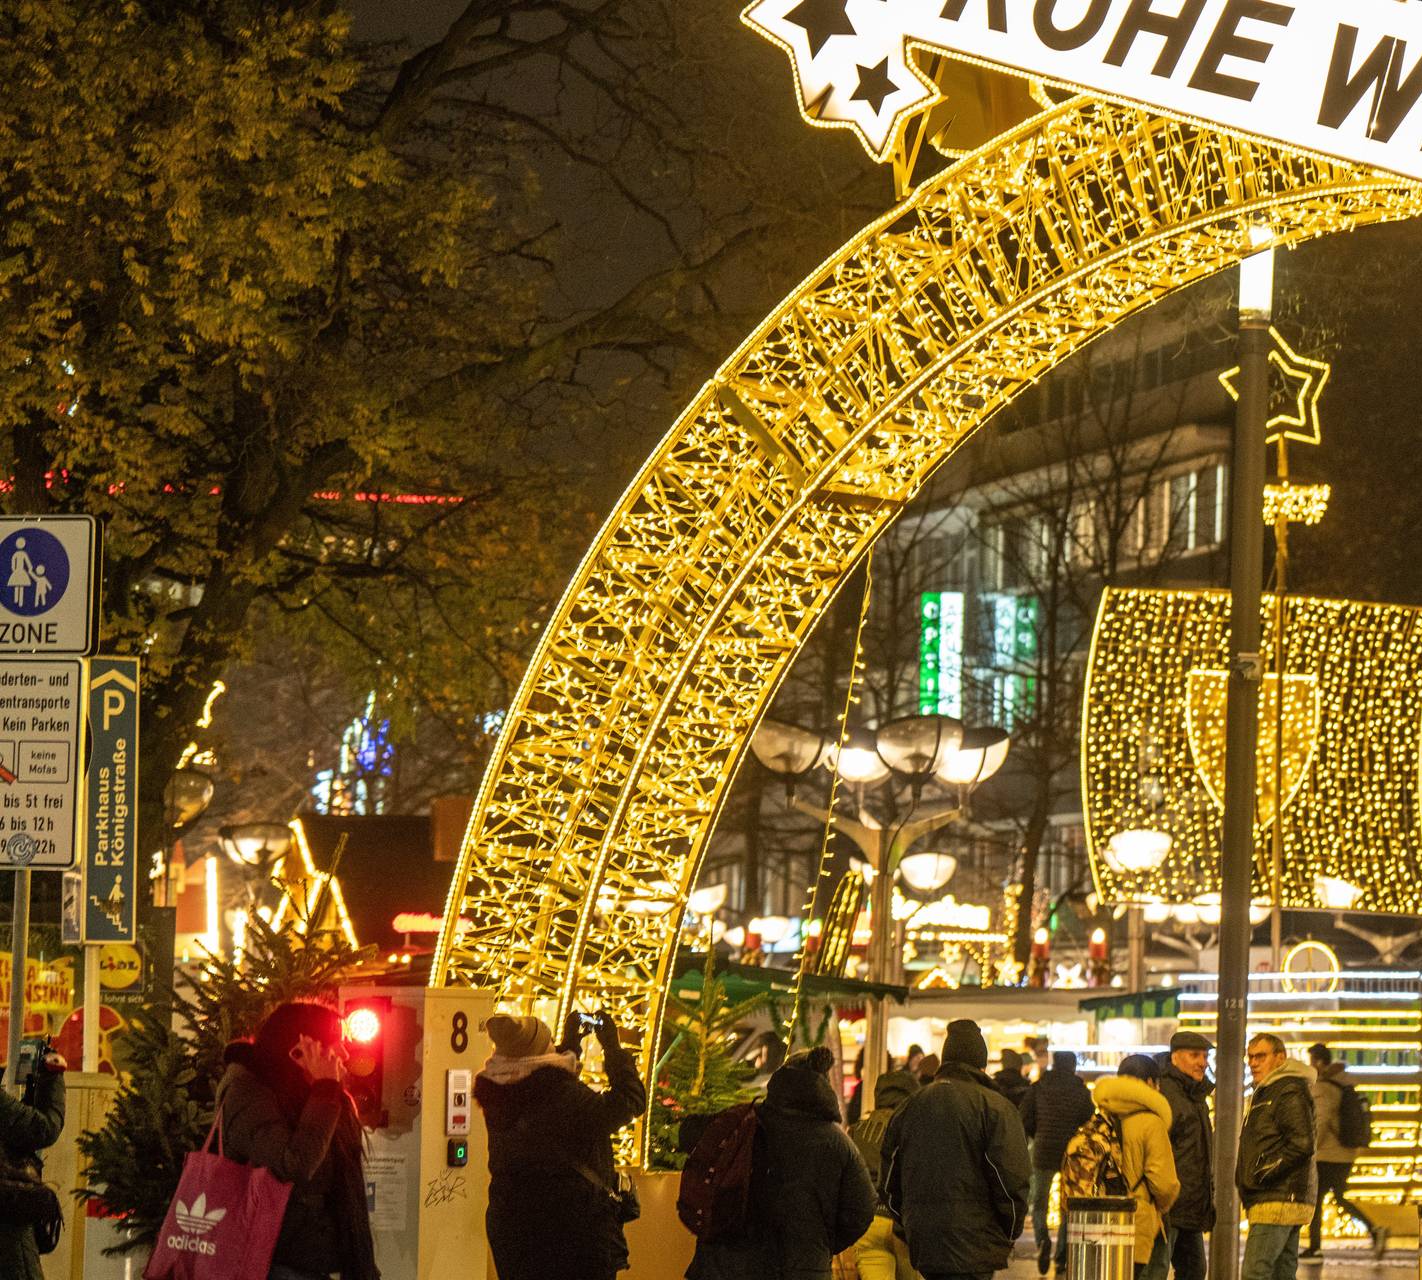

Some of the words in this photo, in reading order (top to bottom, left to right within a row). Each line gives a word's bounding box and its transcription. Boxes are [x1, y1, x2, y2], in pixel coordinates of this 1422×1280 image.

[0, 623, 58, 643] ZONE
[49, 671, 69, 687] und
[103, 689, 126, 731] P
[3, 716, 27, 731] Kein
[32, 716, 70, 731] Parken
[31, 749, 57, 761] keine
[29, 765, 57, 776] Mofas
[4, 793, 20, 808] bis
[26, 793, 38, 808] 5t
[44, 793, 64, 809] frei
[111, 738, 127, 867] Königstraße
[11, 816, 27, 831] bis
[95, 767, 109, 866] Parkhaus
[451, 1011, 469, 1053] 8
[167, 1235, 216, 1256] adidas
